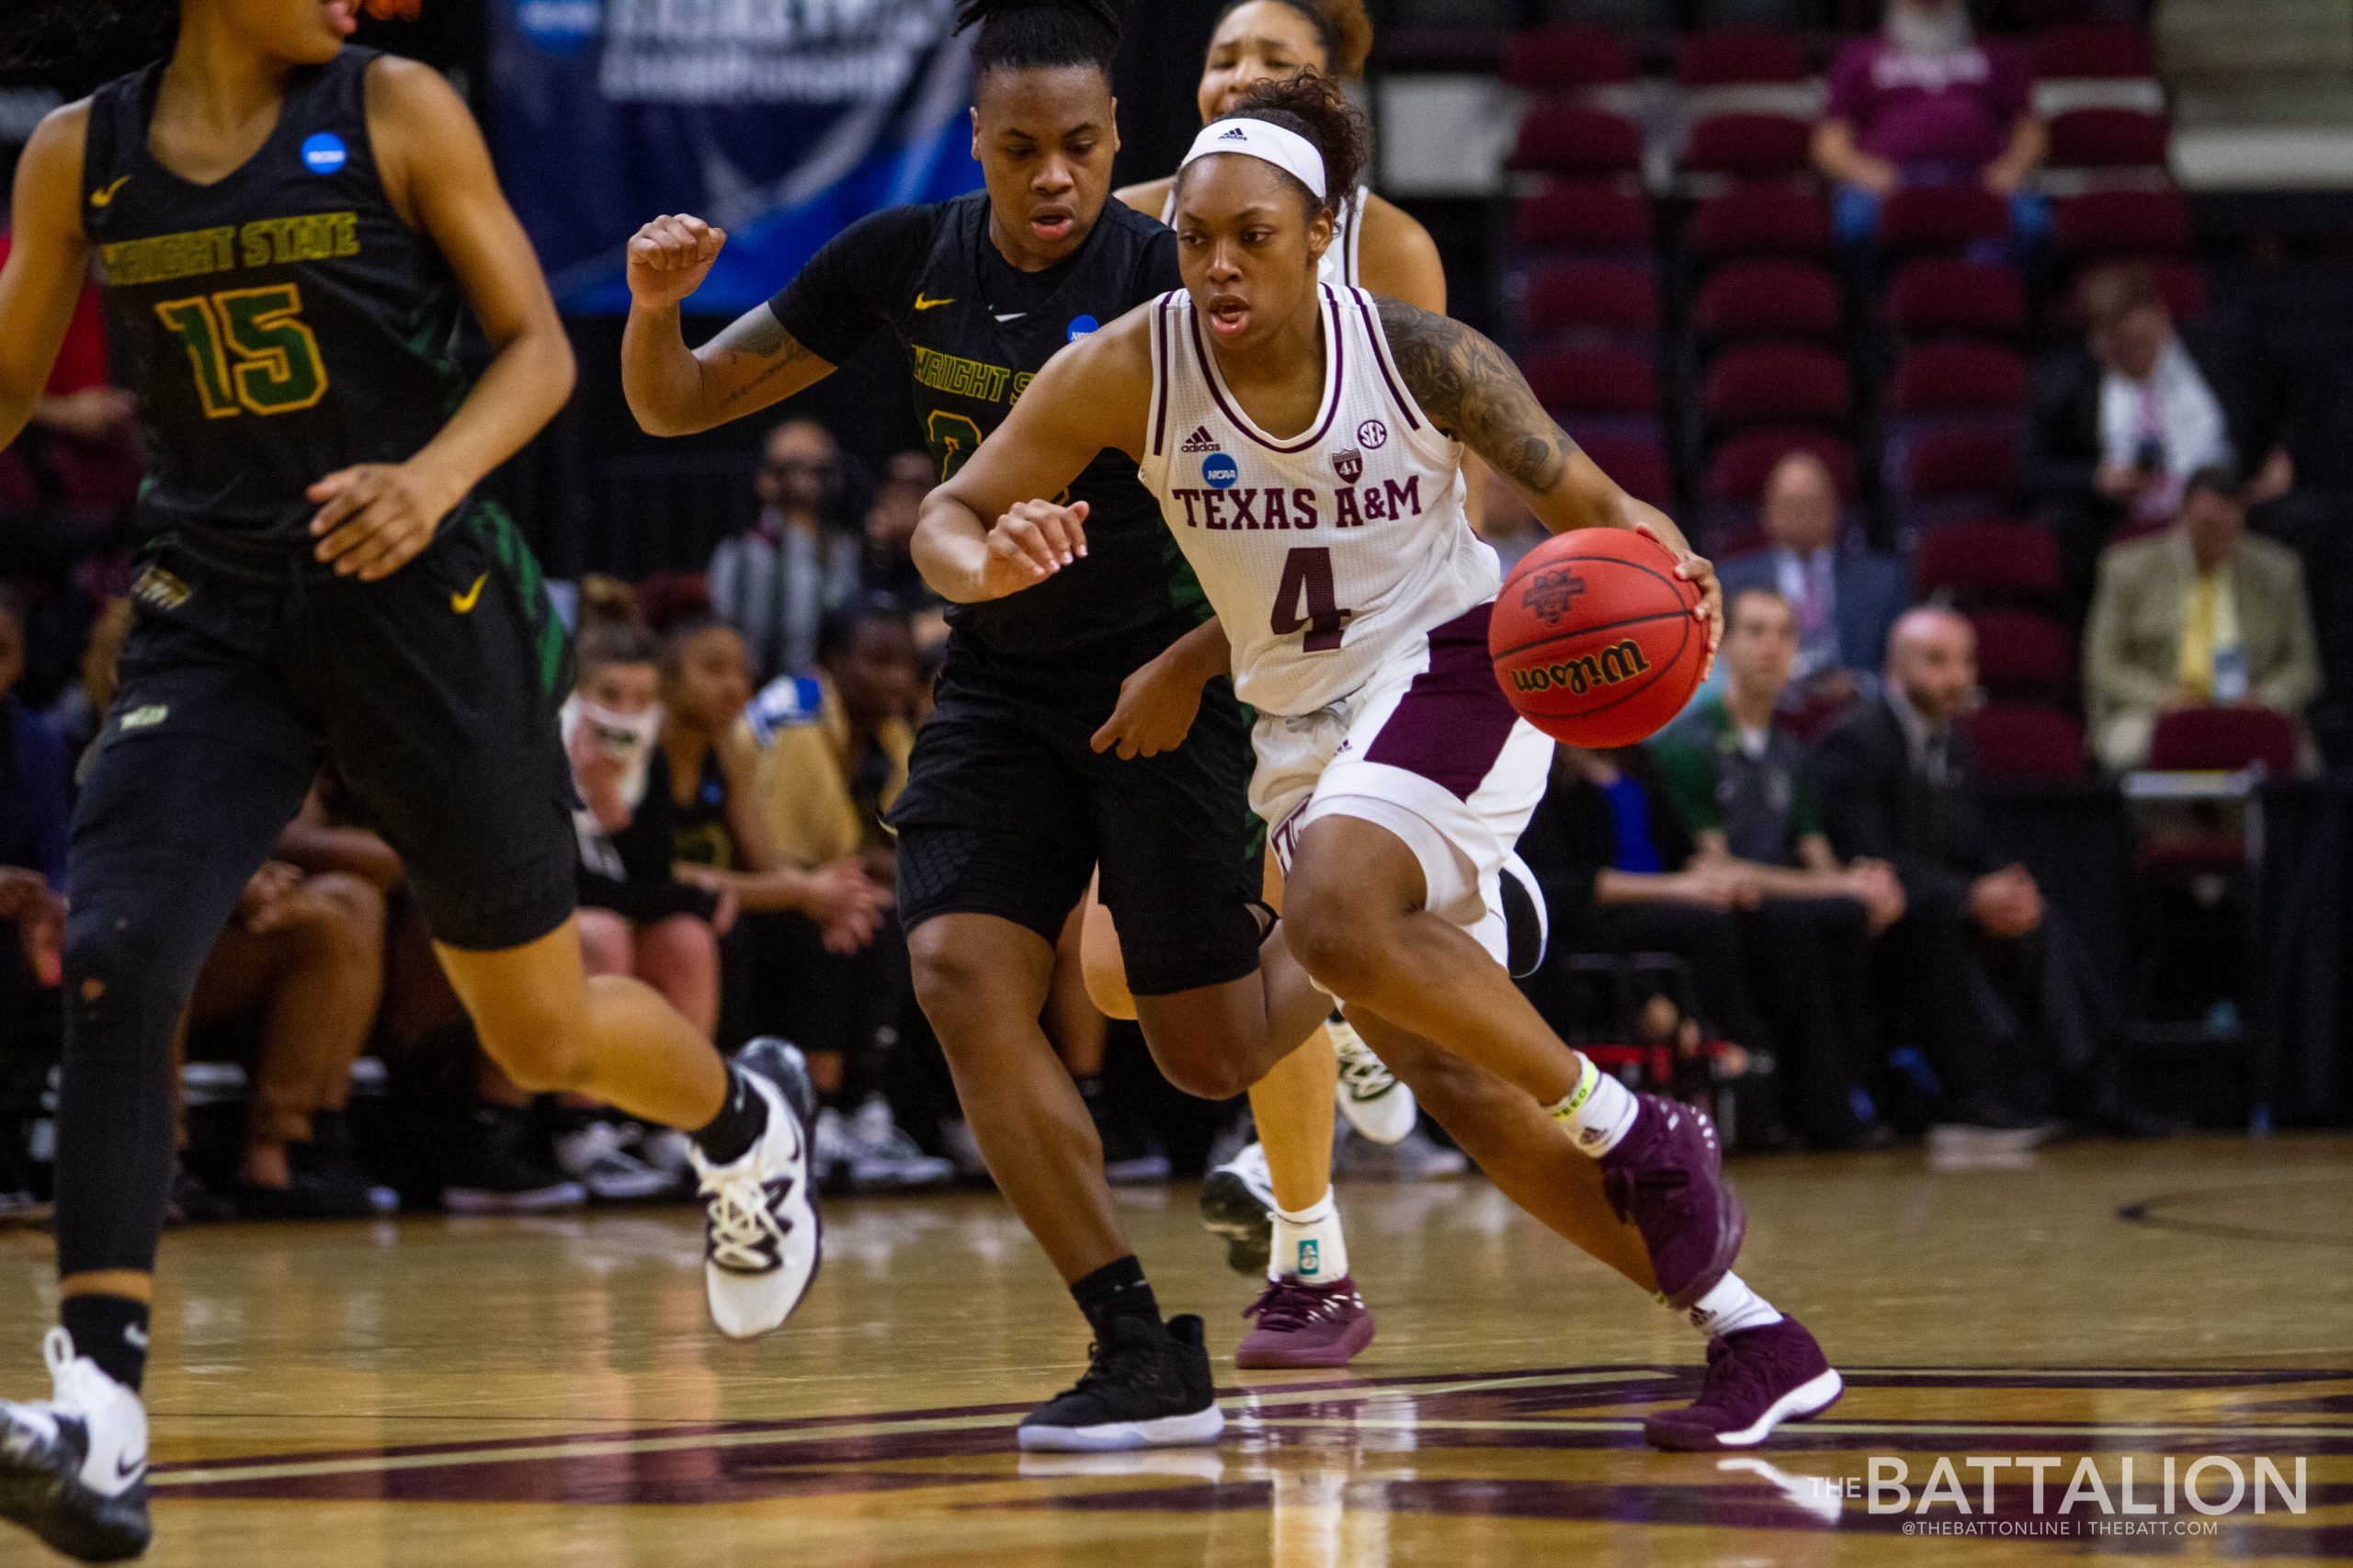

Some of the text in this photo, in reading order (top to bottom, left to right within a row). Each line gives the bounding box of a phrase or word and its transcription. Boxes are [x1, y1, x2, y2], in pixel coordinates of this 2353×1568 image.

[240, 210, 361, 267] STATE
[154, 282, 329, 419] 15
[1181, 442, 1221, 453] adidas
[1208, 470, 1236, 480] NCAA
[1339, 464, 1360, 476] 41
[1172, 474, 1422, 530] TEXAS A&M
[1270, 547, 1352, 653] 4
[1510, 639, 1651, 695] Wilson
